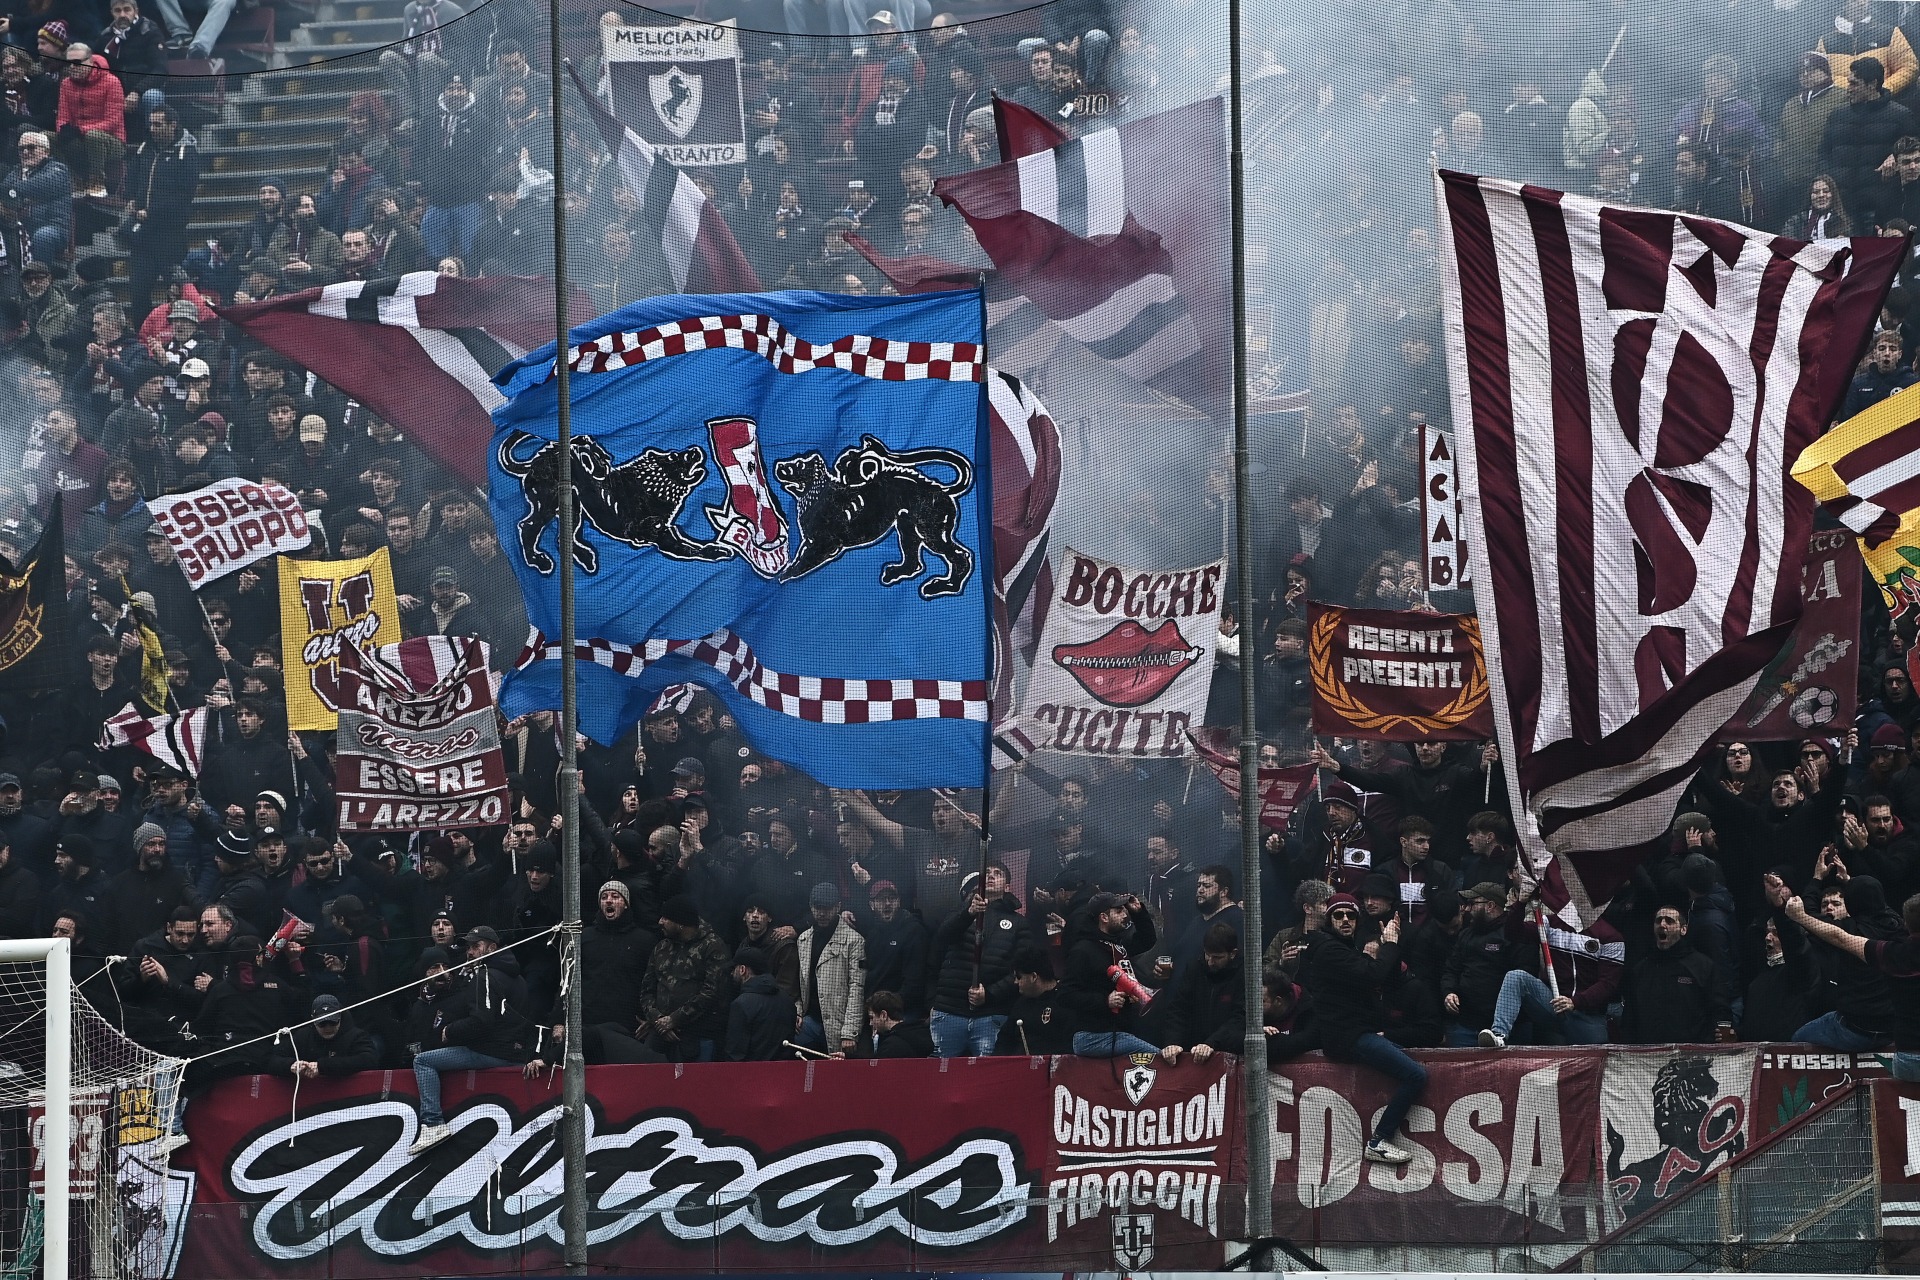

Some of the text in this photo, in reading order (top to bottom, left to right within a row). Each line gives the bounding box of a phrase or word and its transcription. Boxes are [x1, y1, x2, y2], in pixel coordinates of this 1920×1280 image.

[615, 26, 725, 45] MELICIANO
[638, 47, 705, 57] Sound Party
[653, 146, 735, 163] ARANTO
[154, 484, 295, 546] ESSERE
[177, 506, 309, 581] GRUPPO
[1062, 556, 1221, 619] BOCCHE
[1801, 560, 1842, 602] A
[1348, 624, 1454, 654] ASSENTI
[1342, 656, 1463, 688] PRESENTI
[356, 682, 473, 727] AREZZO
[359, 759, 486, 795] ESSERE
[1777, 1054, 1851, 1070] FOSSA
[1053, 1073, 1227, 1148] CASTIGLION
[1048, 1169, 1221, 1244] FIBOCCHI
